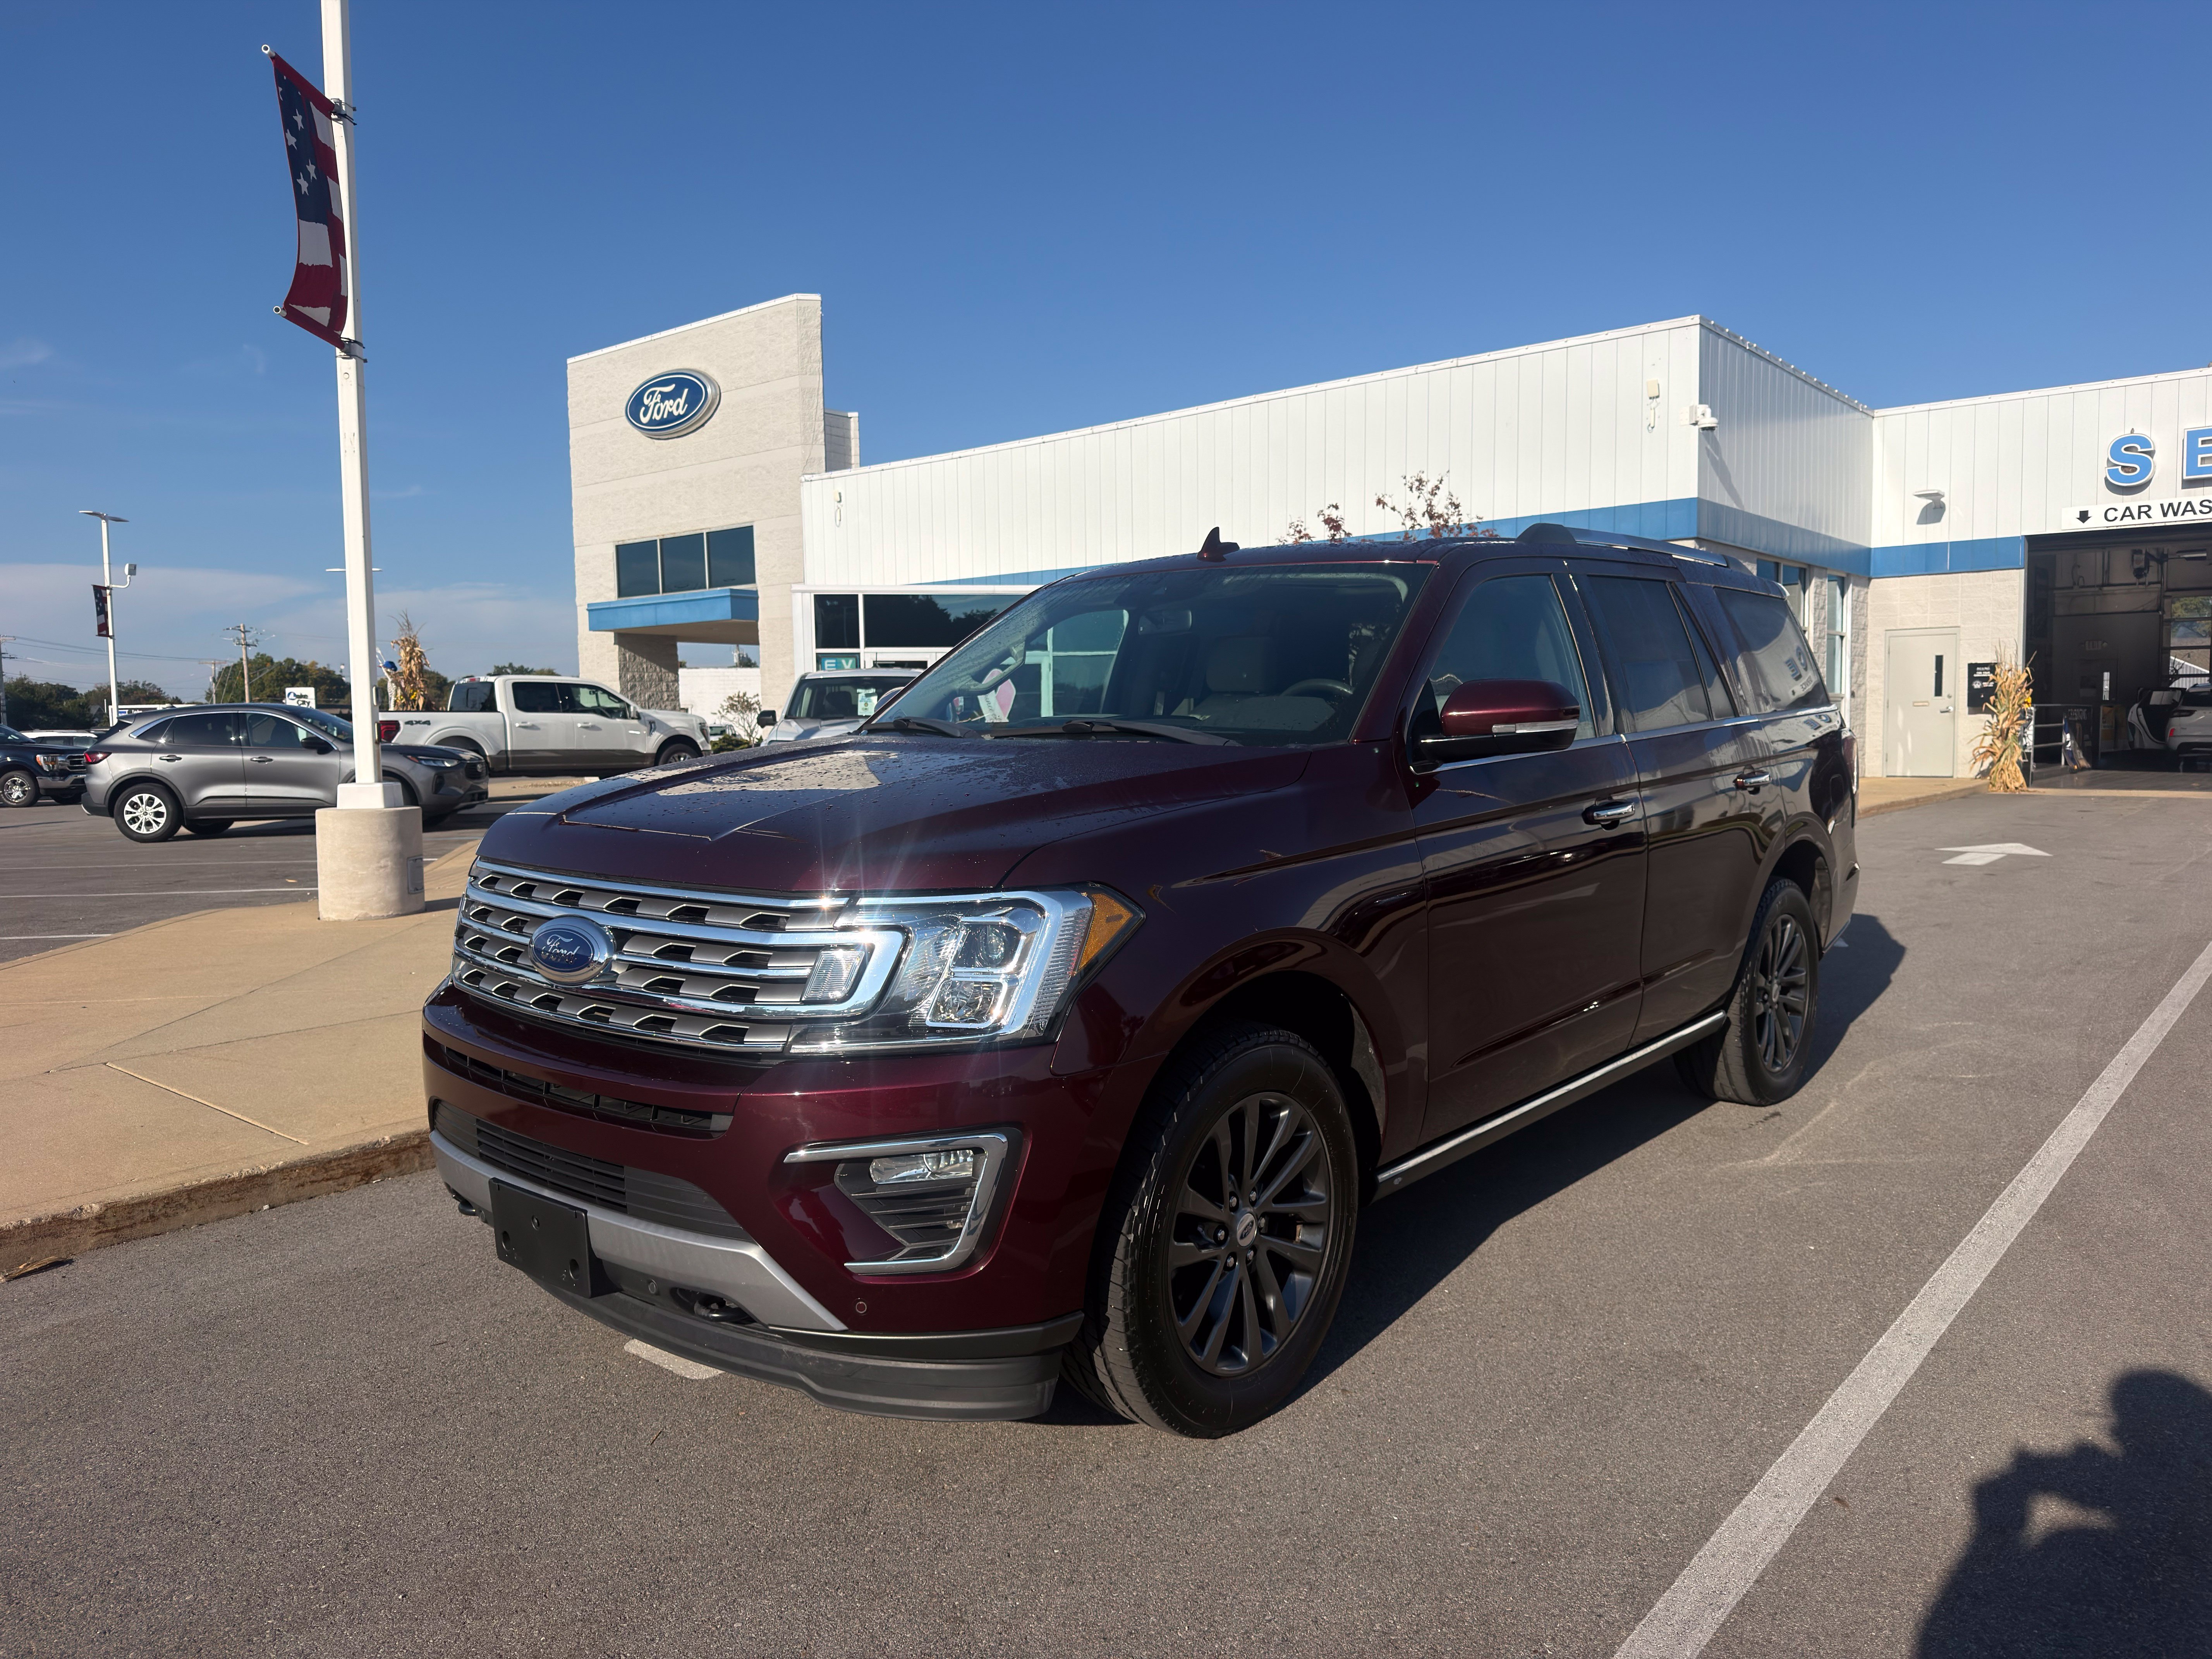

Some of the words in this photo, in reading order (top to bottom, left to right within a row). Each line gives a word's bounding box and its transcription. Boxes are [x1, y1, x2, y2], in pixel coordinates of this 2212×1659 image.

[639, 383, 689, 424] Ford
[2104, 504, 2152, 522] CAR
[824, 659, 853, 670] EV
[541, 934, 580, 964] Ford
